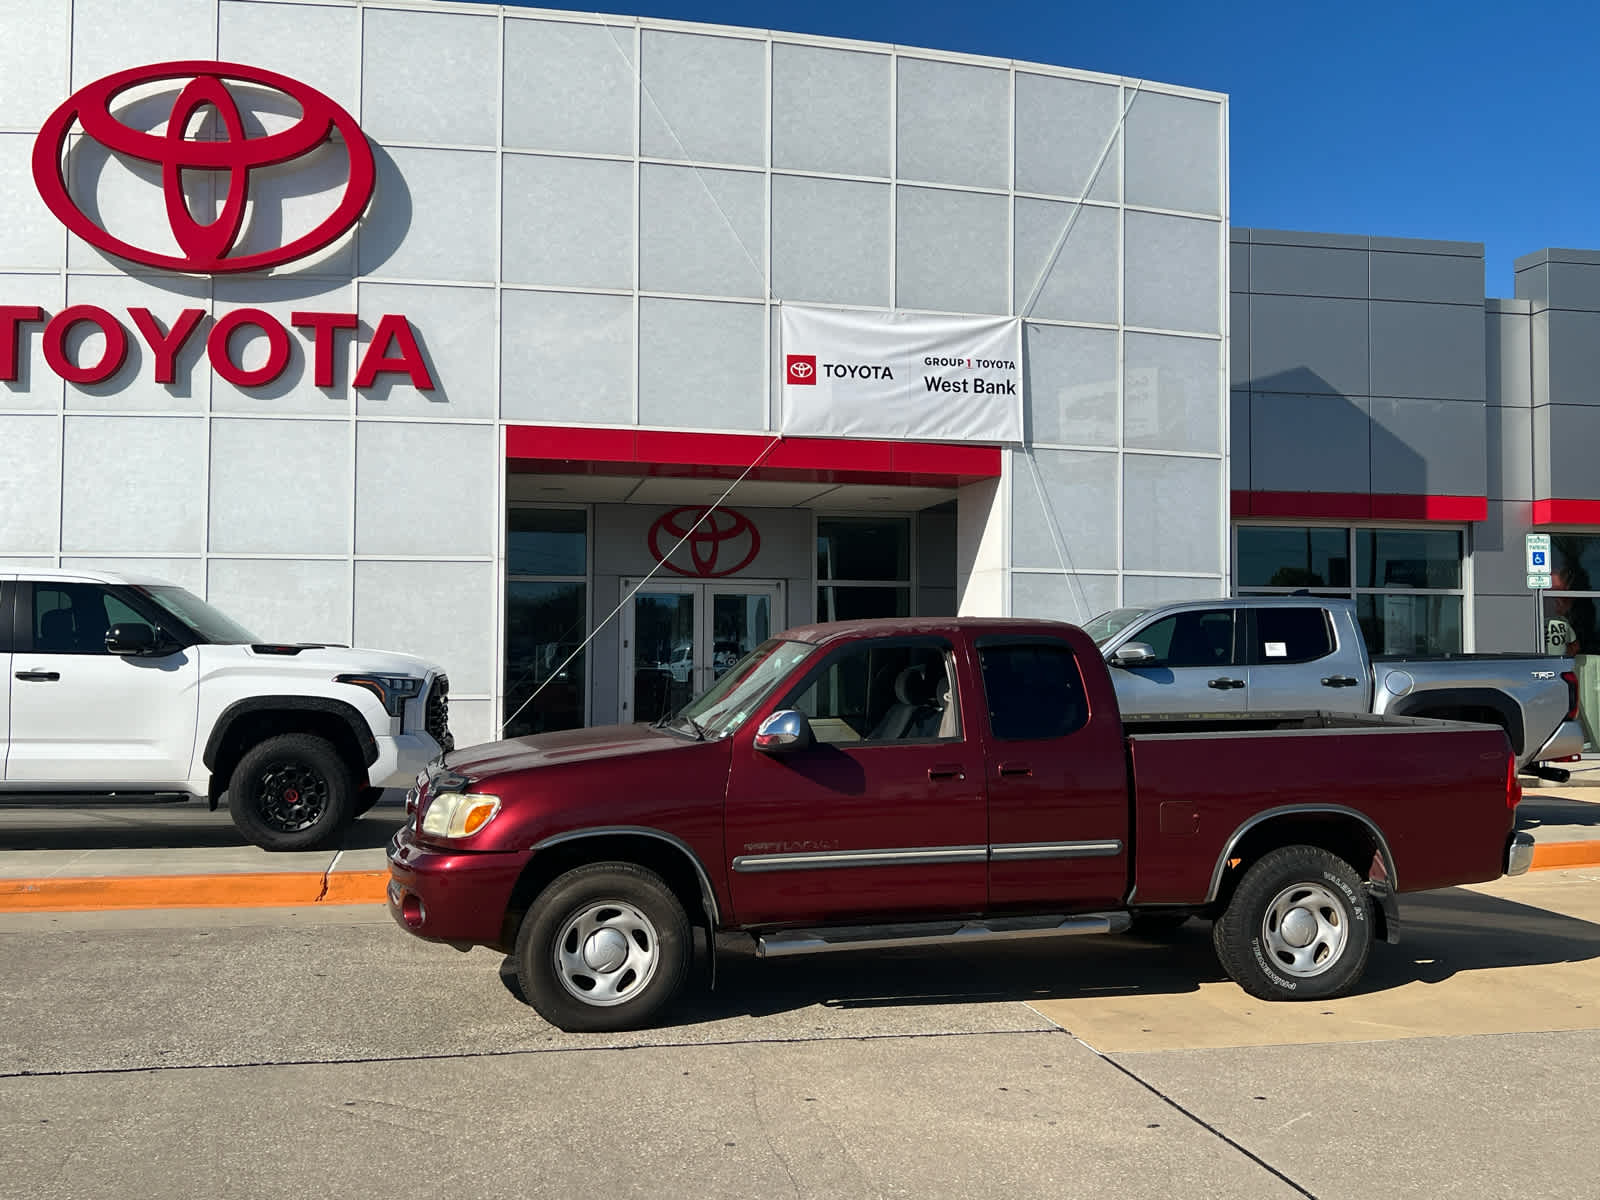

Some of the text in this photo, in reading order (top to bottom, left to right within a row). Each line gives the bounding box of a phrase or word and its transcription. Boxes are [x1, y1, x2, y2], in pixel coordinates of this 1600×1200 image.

[0, 305, 435, 390] TOYOTA
[924, 356, 1016, 370] GROUP 1 TOYOTA
[823, 364, 894, 380] TOYOTA
[924, 376, 1016, 395] West Bank
